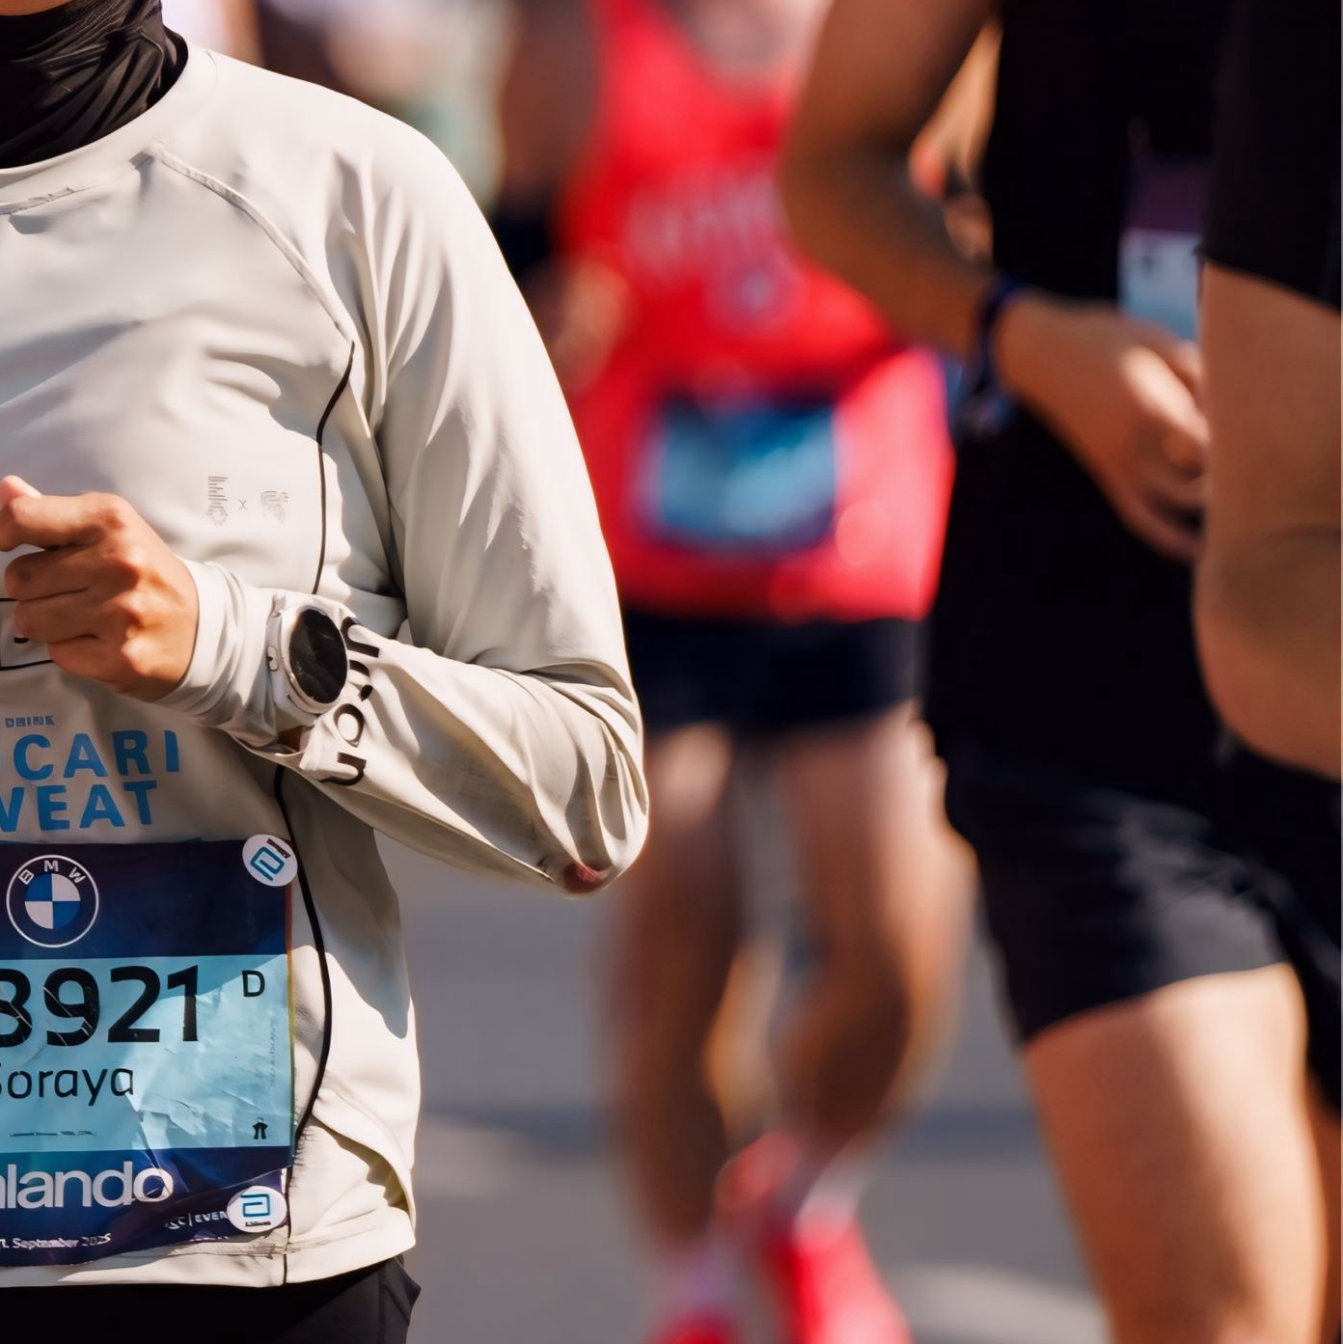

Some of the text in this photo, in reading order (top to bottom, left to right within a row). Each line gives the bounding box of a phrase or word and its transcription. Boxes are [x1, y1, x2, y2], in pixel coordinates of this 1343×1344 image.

[5, 715, 55, 729] DRINK
[18, 859, 86, 885] BMW
[242, 970, 266, 998] D
